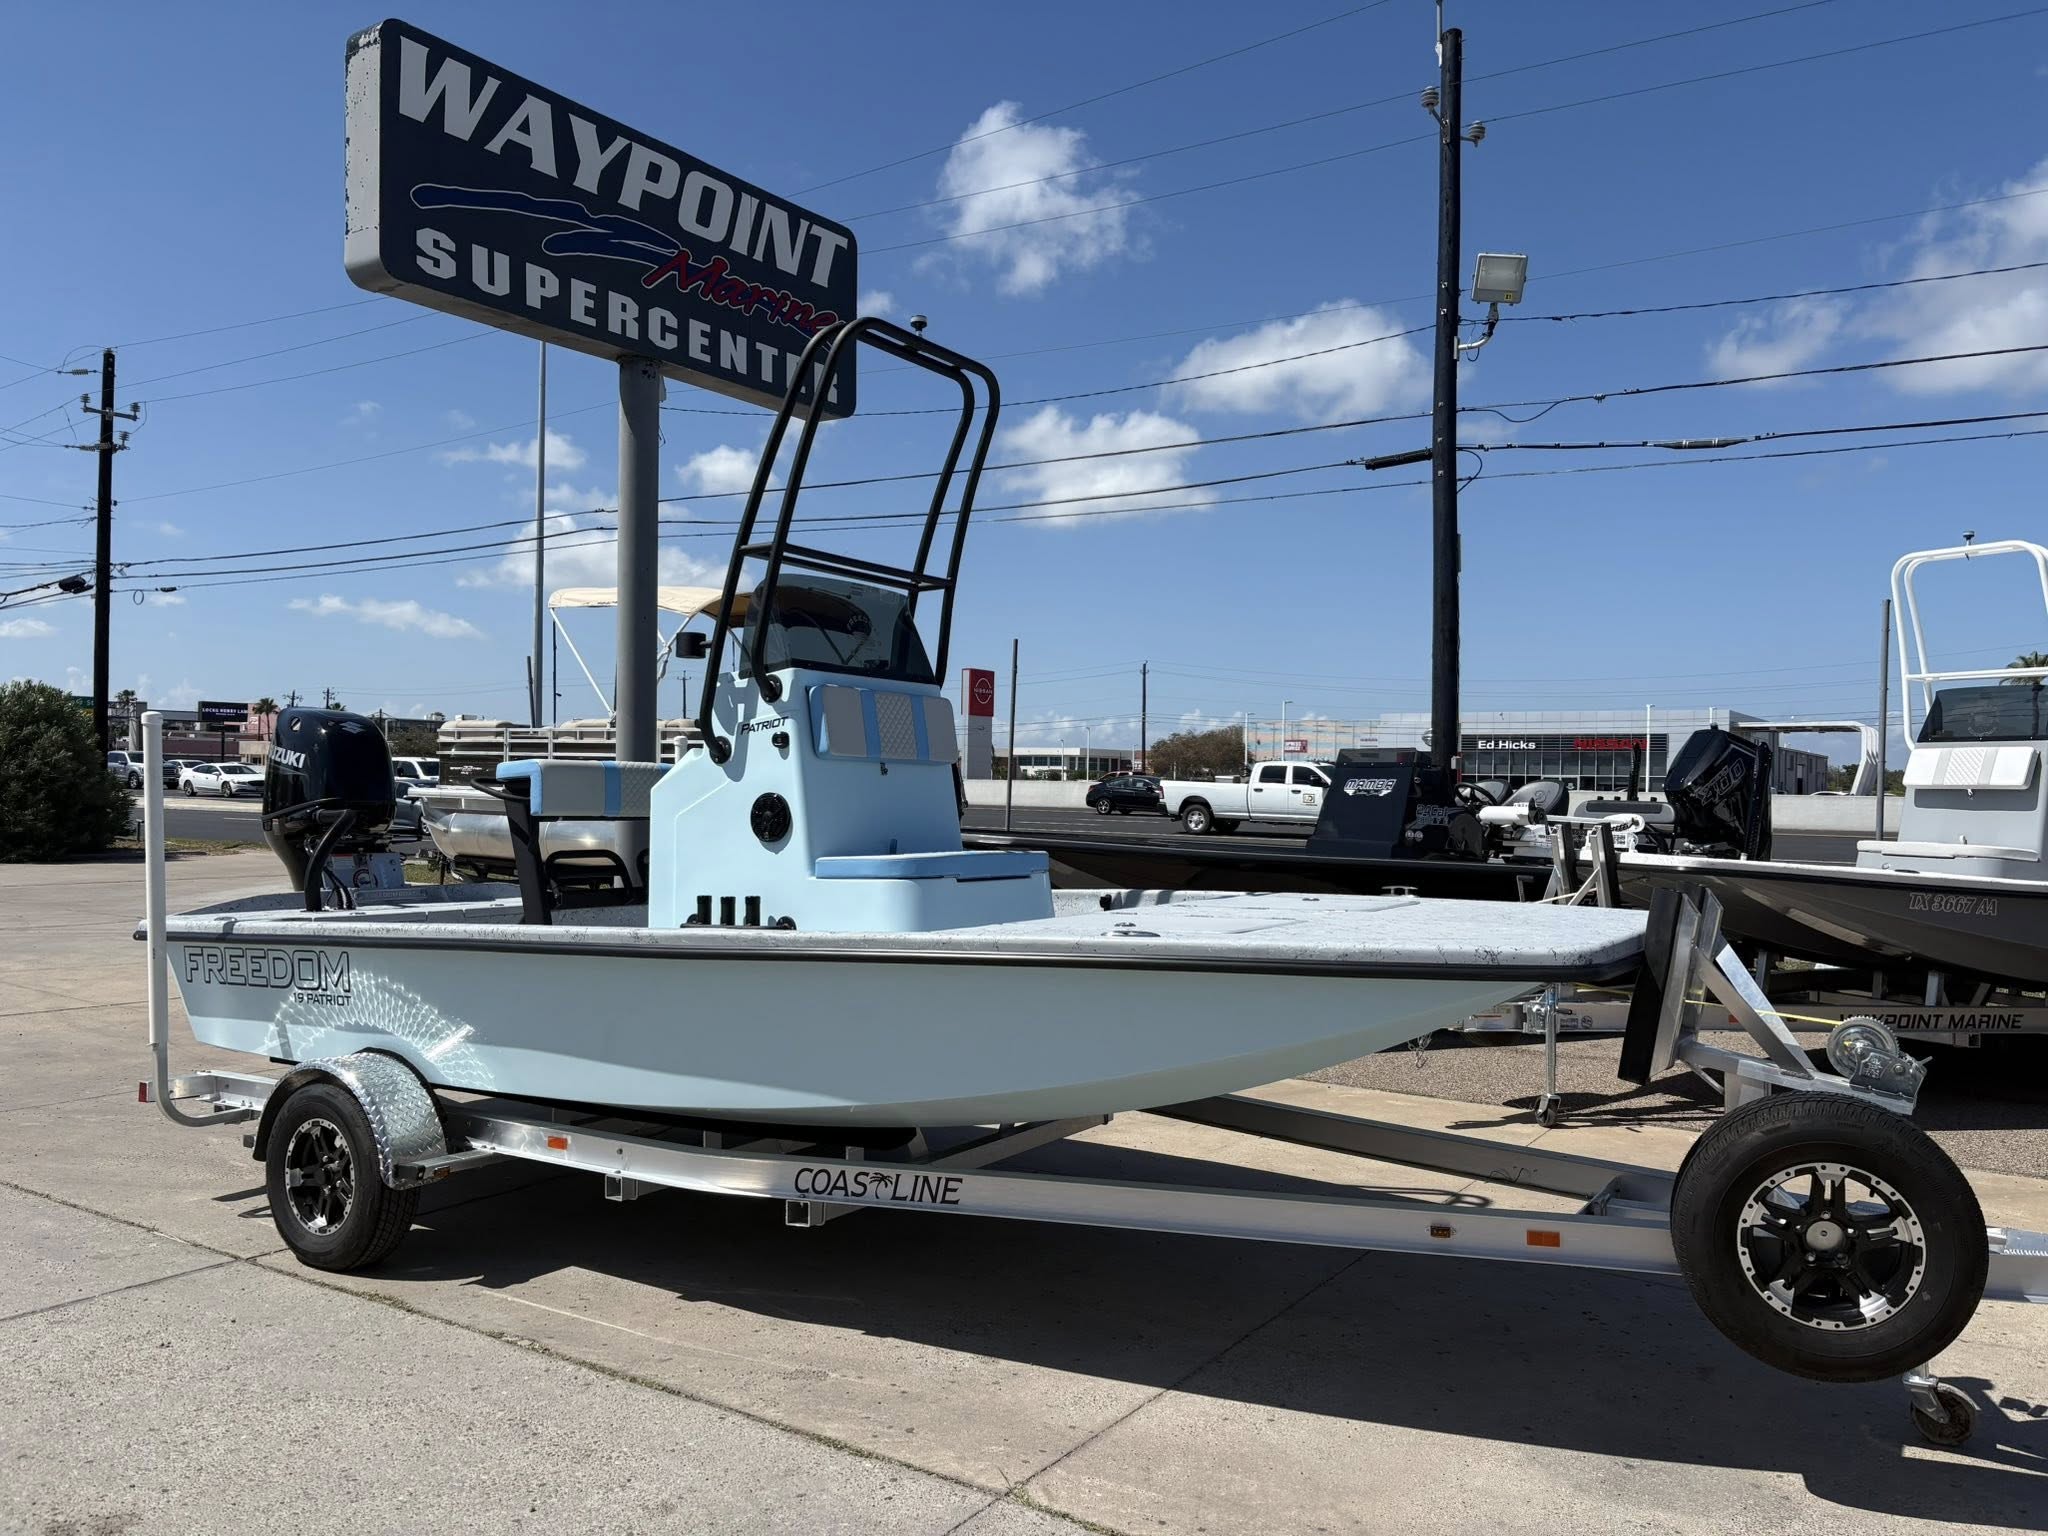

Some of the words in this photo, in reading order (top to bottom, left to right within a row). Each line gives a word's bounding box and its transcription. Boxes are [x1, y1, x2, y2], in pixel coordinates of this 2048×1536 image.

[400, 36, 848, 288] WAYPOINT
[641, 248, 840, 334] Marine
[741, 716, 789, 735] PATRIOT
[1478, 740, 1494, 749] Ed
[1499, 740, 1536, 750] Hicks
[1573, 738, 1647, 751] NISSAN
[1344, 778, 1397, 790] MAMBA
[1909, 892, 1932, 910] TX
[1931, 894, 1976, 914] 3667
[1975, 898, 1998, 916] AA
[184, 945, 351, 992] FREEDOM
[293, 992, 304, 1004] 19
[307, 993, 351, 1006] PATRIOT
[1947, 1014, 2025, 1029] MARINE
